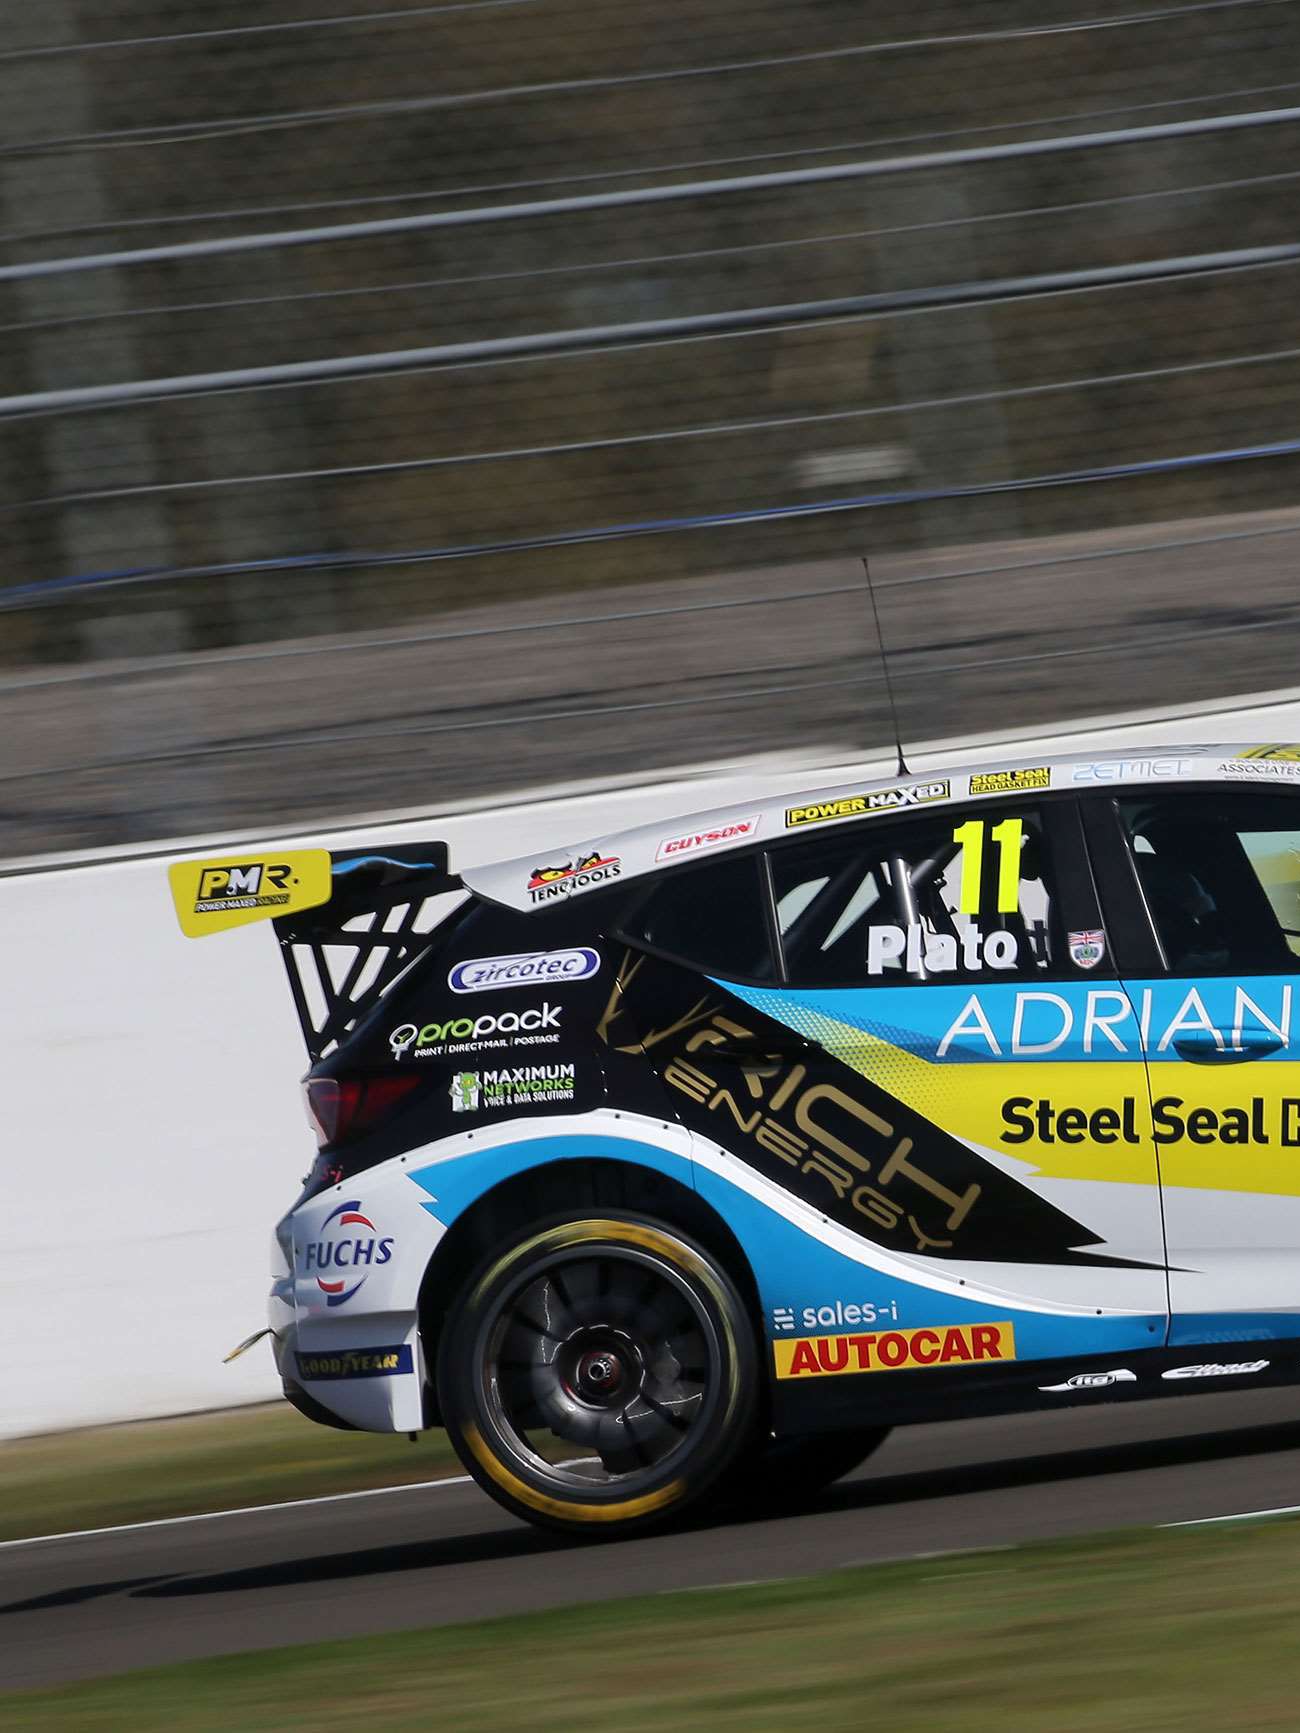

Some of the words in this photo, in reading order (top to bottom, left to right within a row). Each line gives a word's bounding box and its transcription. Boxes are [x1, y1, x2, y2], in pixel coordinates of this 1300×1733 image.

[971, 773, 1011, 785] Steel
[1014, 768, 1049, 780] Seal
[791, 797, 866, 822] POWER
[868, 783, 945, 808] MAXED
[664, 821, 752, 853] GUYSON
[953, 818, 1023, 915] 11
[867, 923, 1018, 975] Plato
[472, 957, 578, 983] zircotec
[415, 1002, 563, 1047] propack
[414, 1046, 443, 1058] PRINT
[514, 1034, 561, 1047] POSTAGE
[483, 1063, 575, 1085] MAXIMUM
[484, 1078, 575, 1096] NETWORKS
[533, 1090, 574, 1102] SOLUTIONS
[1000, 1097, 1140, 1145] Steel
[1152, 1097, 1269, 1145] Seal
[663, 1059, 953, 1251] ENERGY
[305, 1237, 395, 1271] FUCHS
[802, 1300, 898, 1329] sales-i
[789, 1325, 1002, 1375] AUTOCAR
